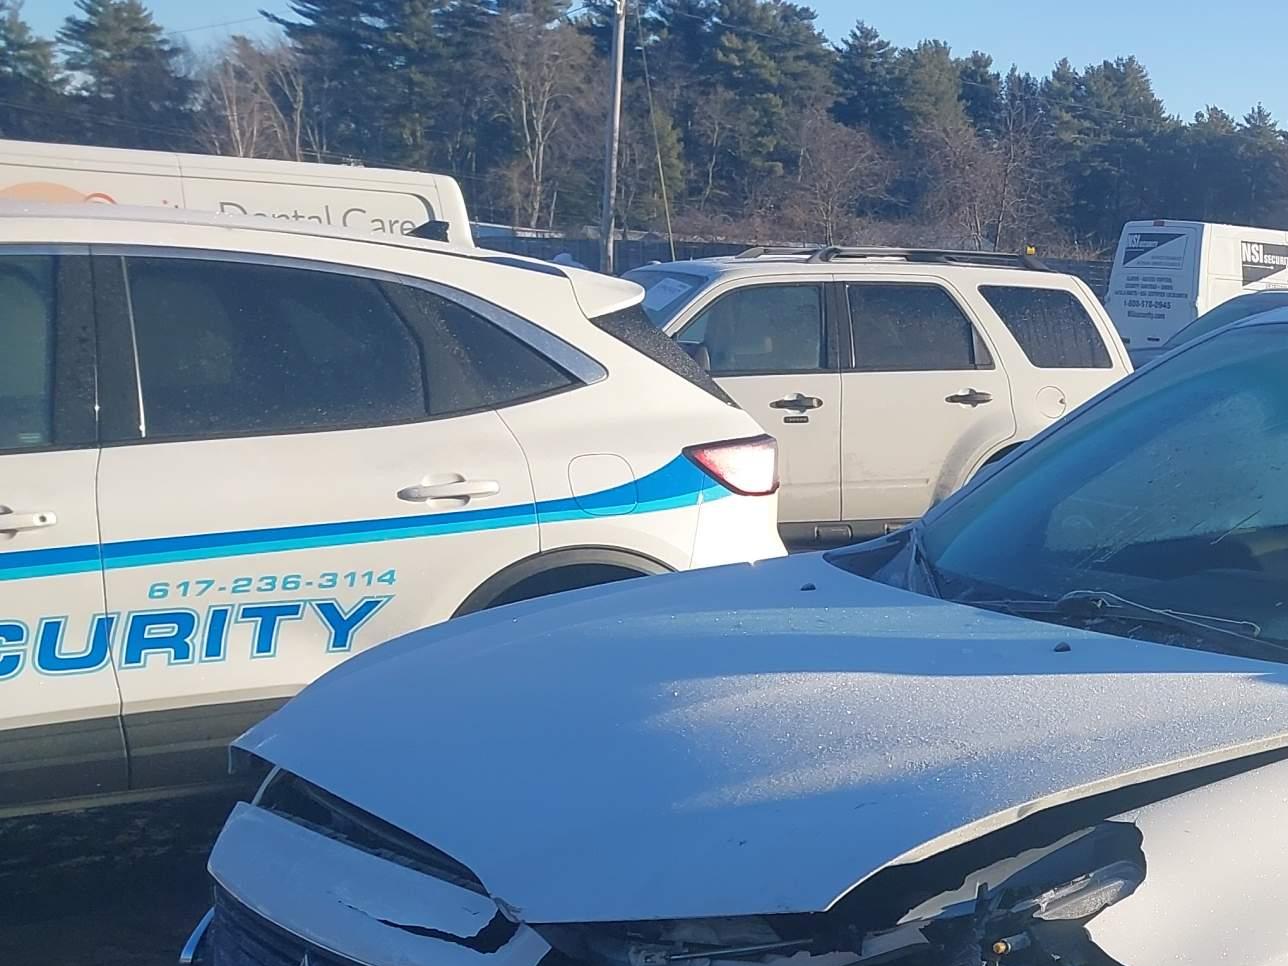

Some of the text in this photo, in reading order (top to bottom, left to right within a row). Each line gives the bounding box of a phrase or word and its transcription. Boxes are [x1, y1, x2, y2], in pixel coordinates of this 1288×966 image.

[219, 201, 416, 235] Dtal Care
[1241, 242, 1264, 264] NSI
[147, 569, 398, 599] 617-236-3114
